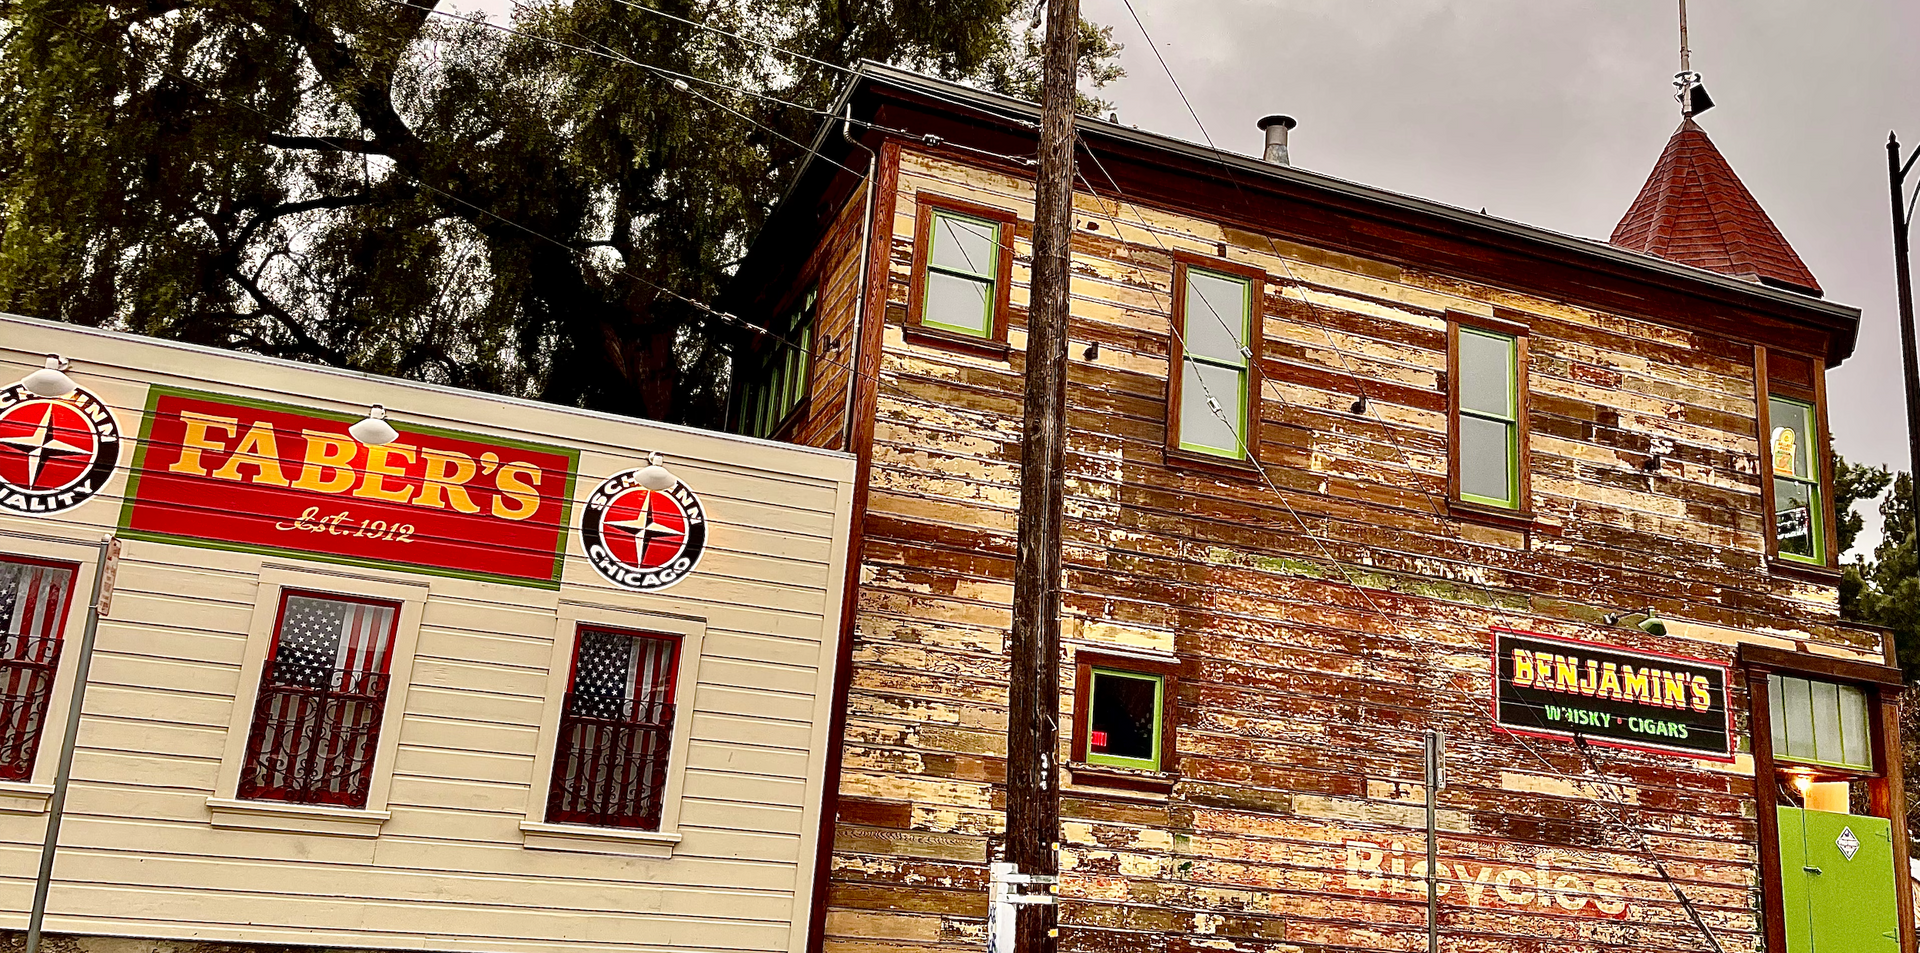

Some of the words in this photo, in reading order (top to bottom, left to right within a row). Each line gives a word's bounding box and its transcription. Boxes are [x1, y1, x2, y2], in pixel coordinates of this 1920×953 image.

[168, 409, 542, 521] FABER'S
[275, 506, 354, 536] Est.
[353, 519, 415, 543] 1912
[591, 474, 702, 525] SCHINN
[590, 544, 691, 586] CHICAGO
[1511, 648, 1712, 714] BENJAMIN'S
[1628, 716, 1689, 739] CIGARS
[1344, 839, 1630, 916] Bicycles
